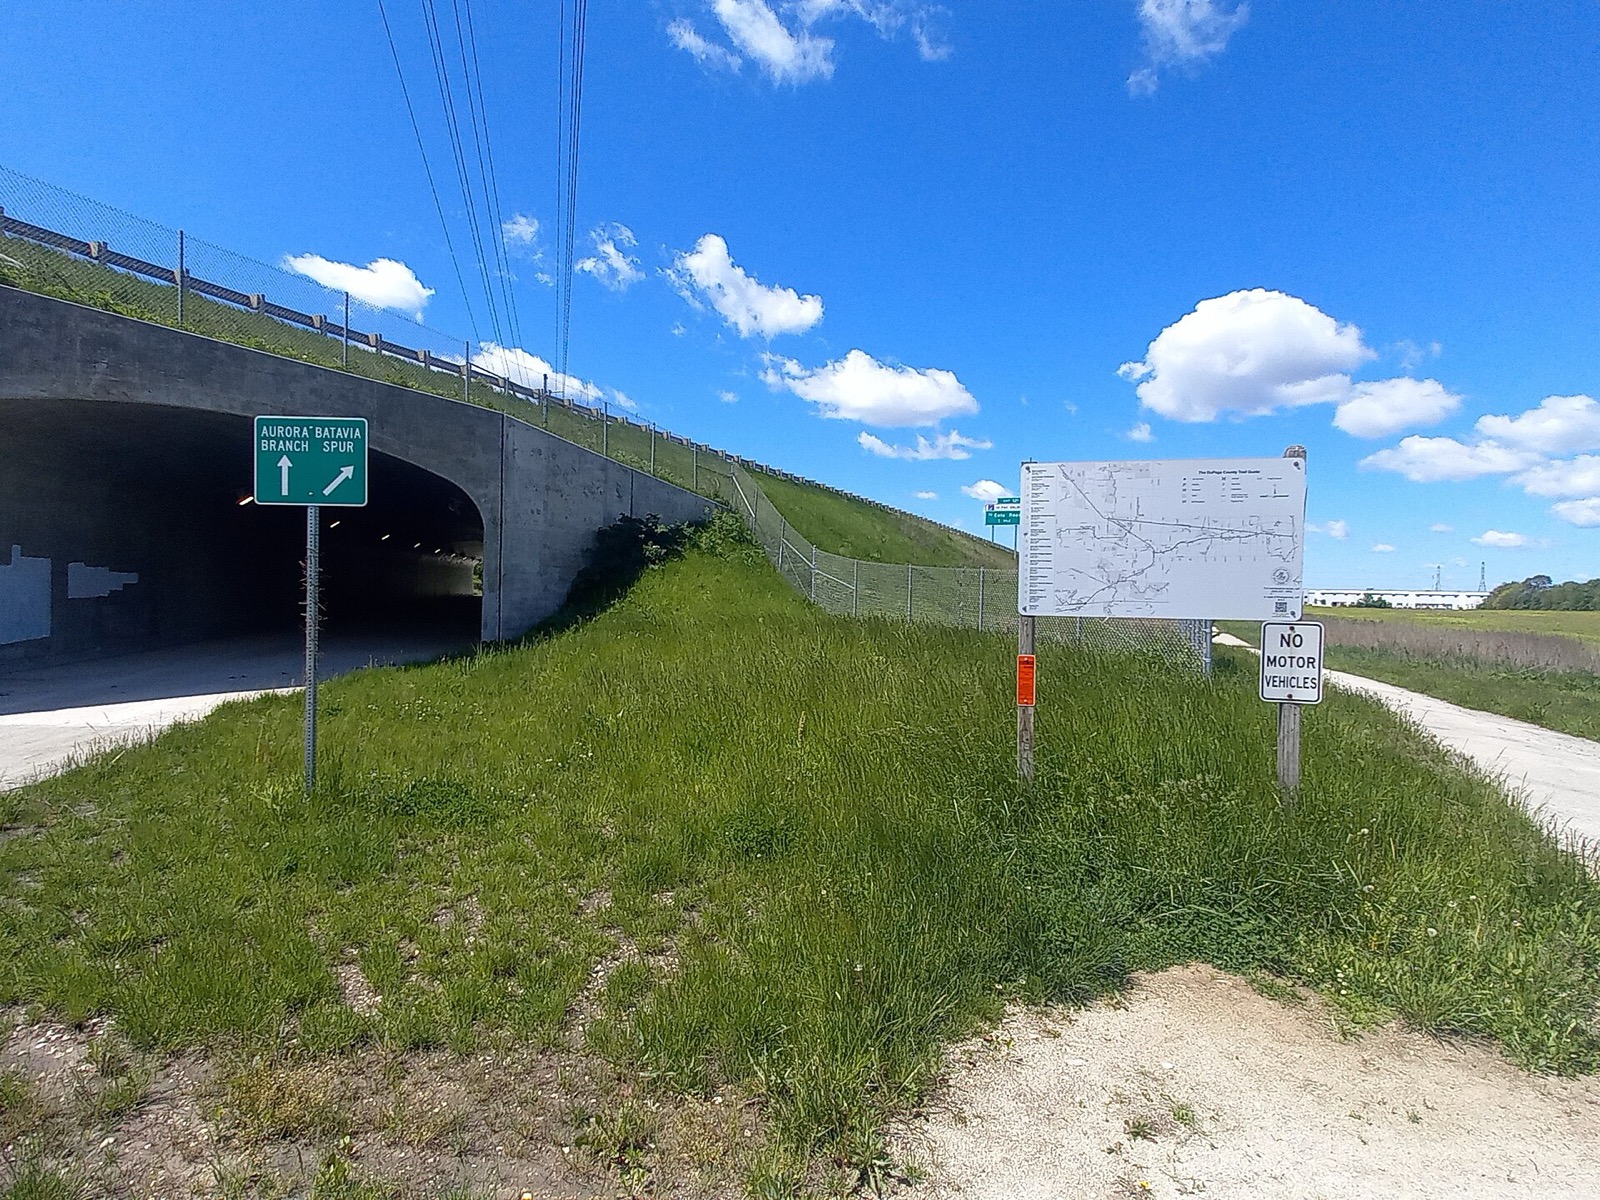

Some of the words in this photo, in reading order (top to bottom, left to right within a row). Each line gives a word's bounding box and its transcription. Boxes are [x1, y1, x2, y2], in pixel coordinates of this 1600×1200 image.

[261, 426, 309, 438] AURORA
[315, 427, 361, 439] BATAVIA
[261, 440, 309, 452] BRANCH
[322, 441, 354, 453] SPUR
[1280, 633, 1303, 648] NO
[1266, 655, 1316, 669] MOTOR
[1265, 675, 1317, 690] VEHICLES
